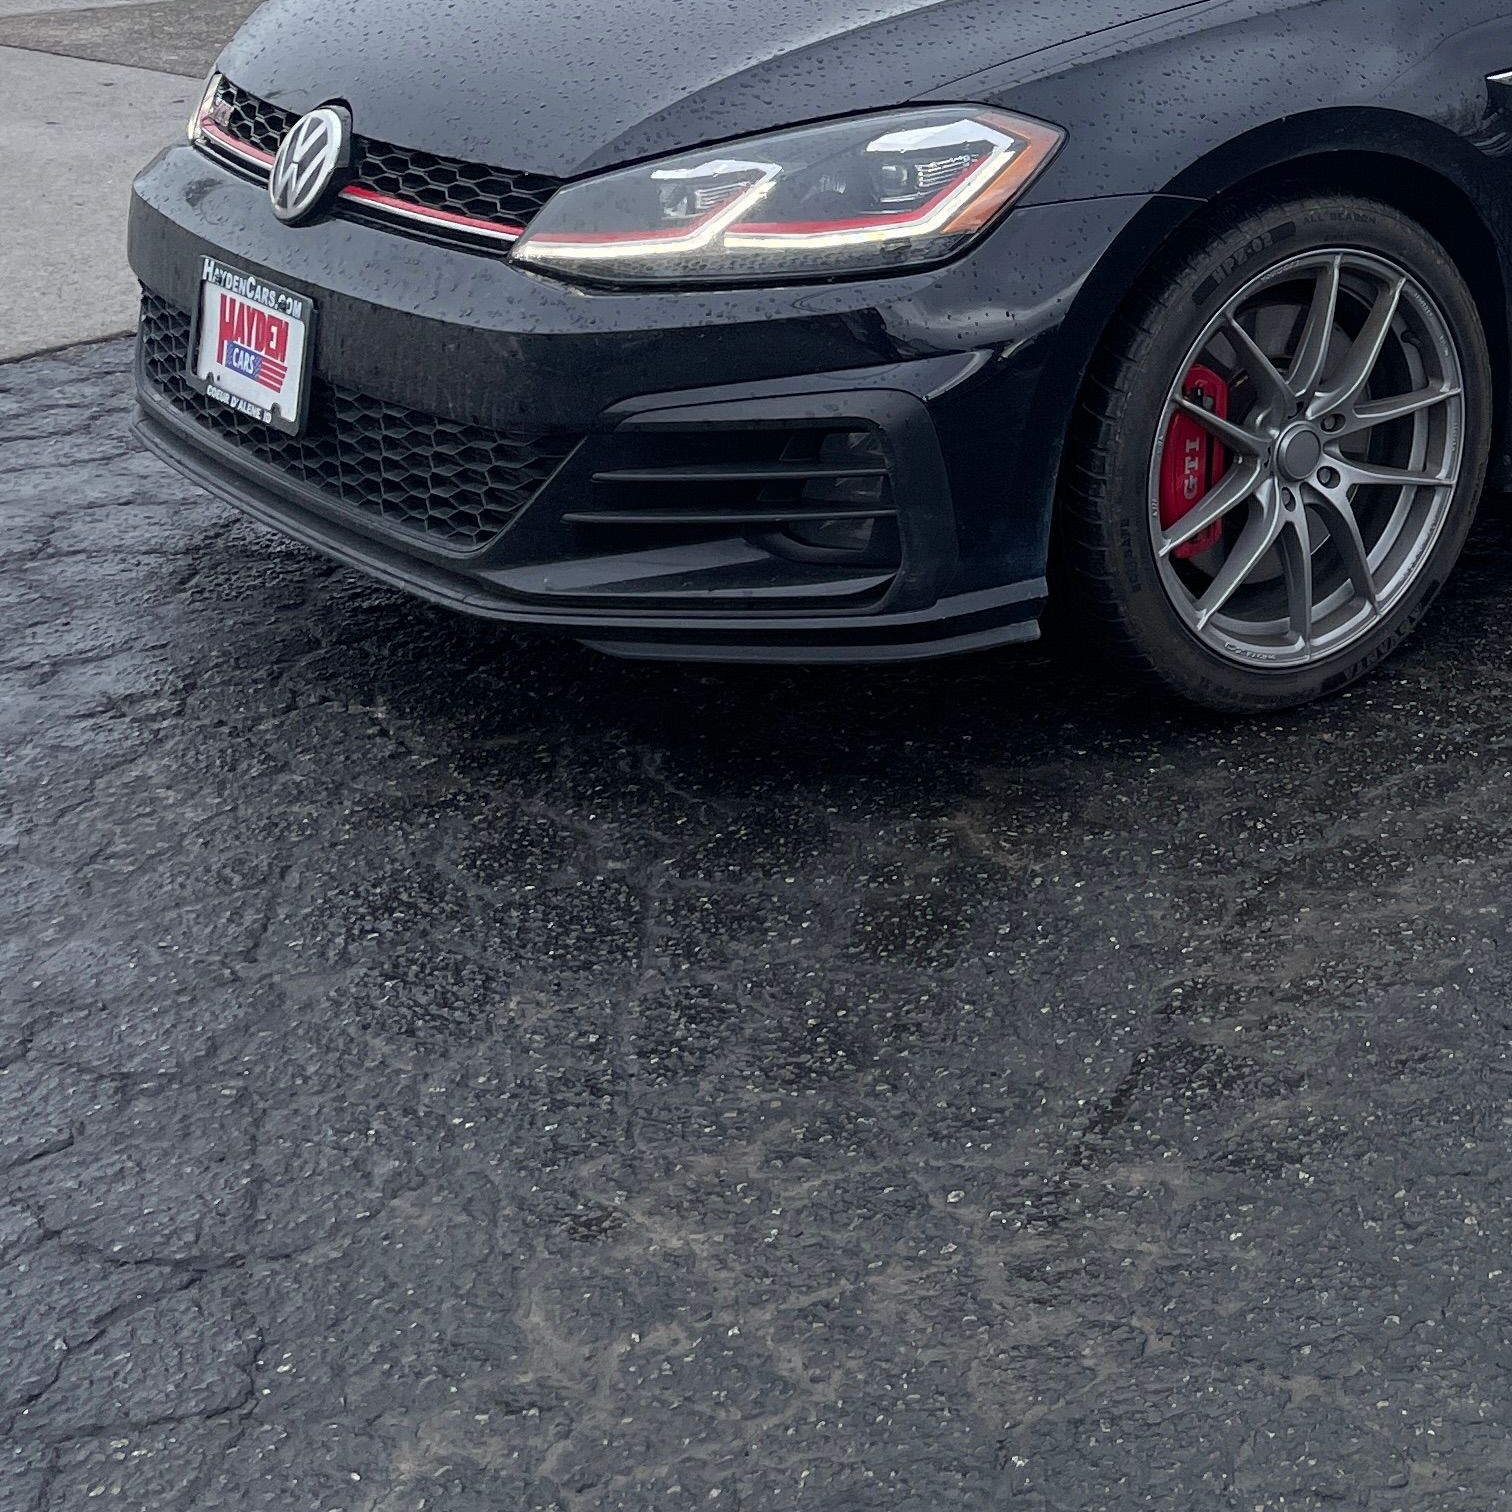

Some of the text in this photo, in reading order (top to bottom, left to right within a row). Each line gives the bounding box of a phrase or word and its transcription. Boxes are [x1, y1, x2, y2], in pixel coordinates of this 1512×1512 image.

[216, 292, 290, 366] HAYDEN
[232, 347, 256, 374] CARS
[1183, 436, 1200, 500] GTI
